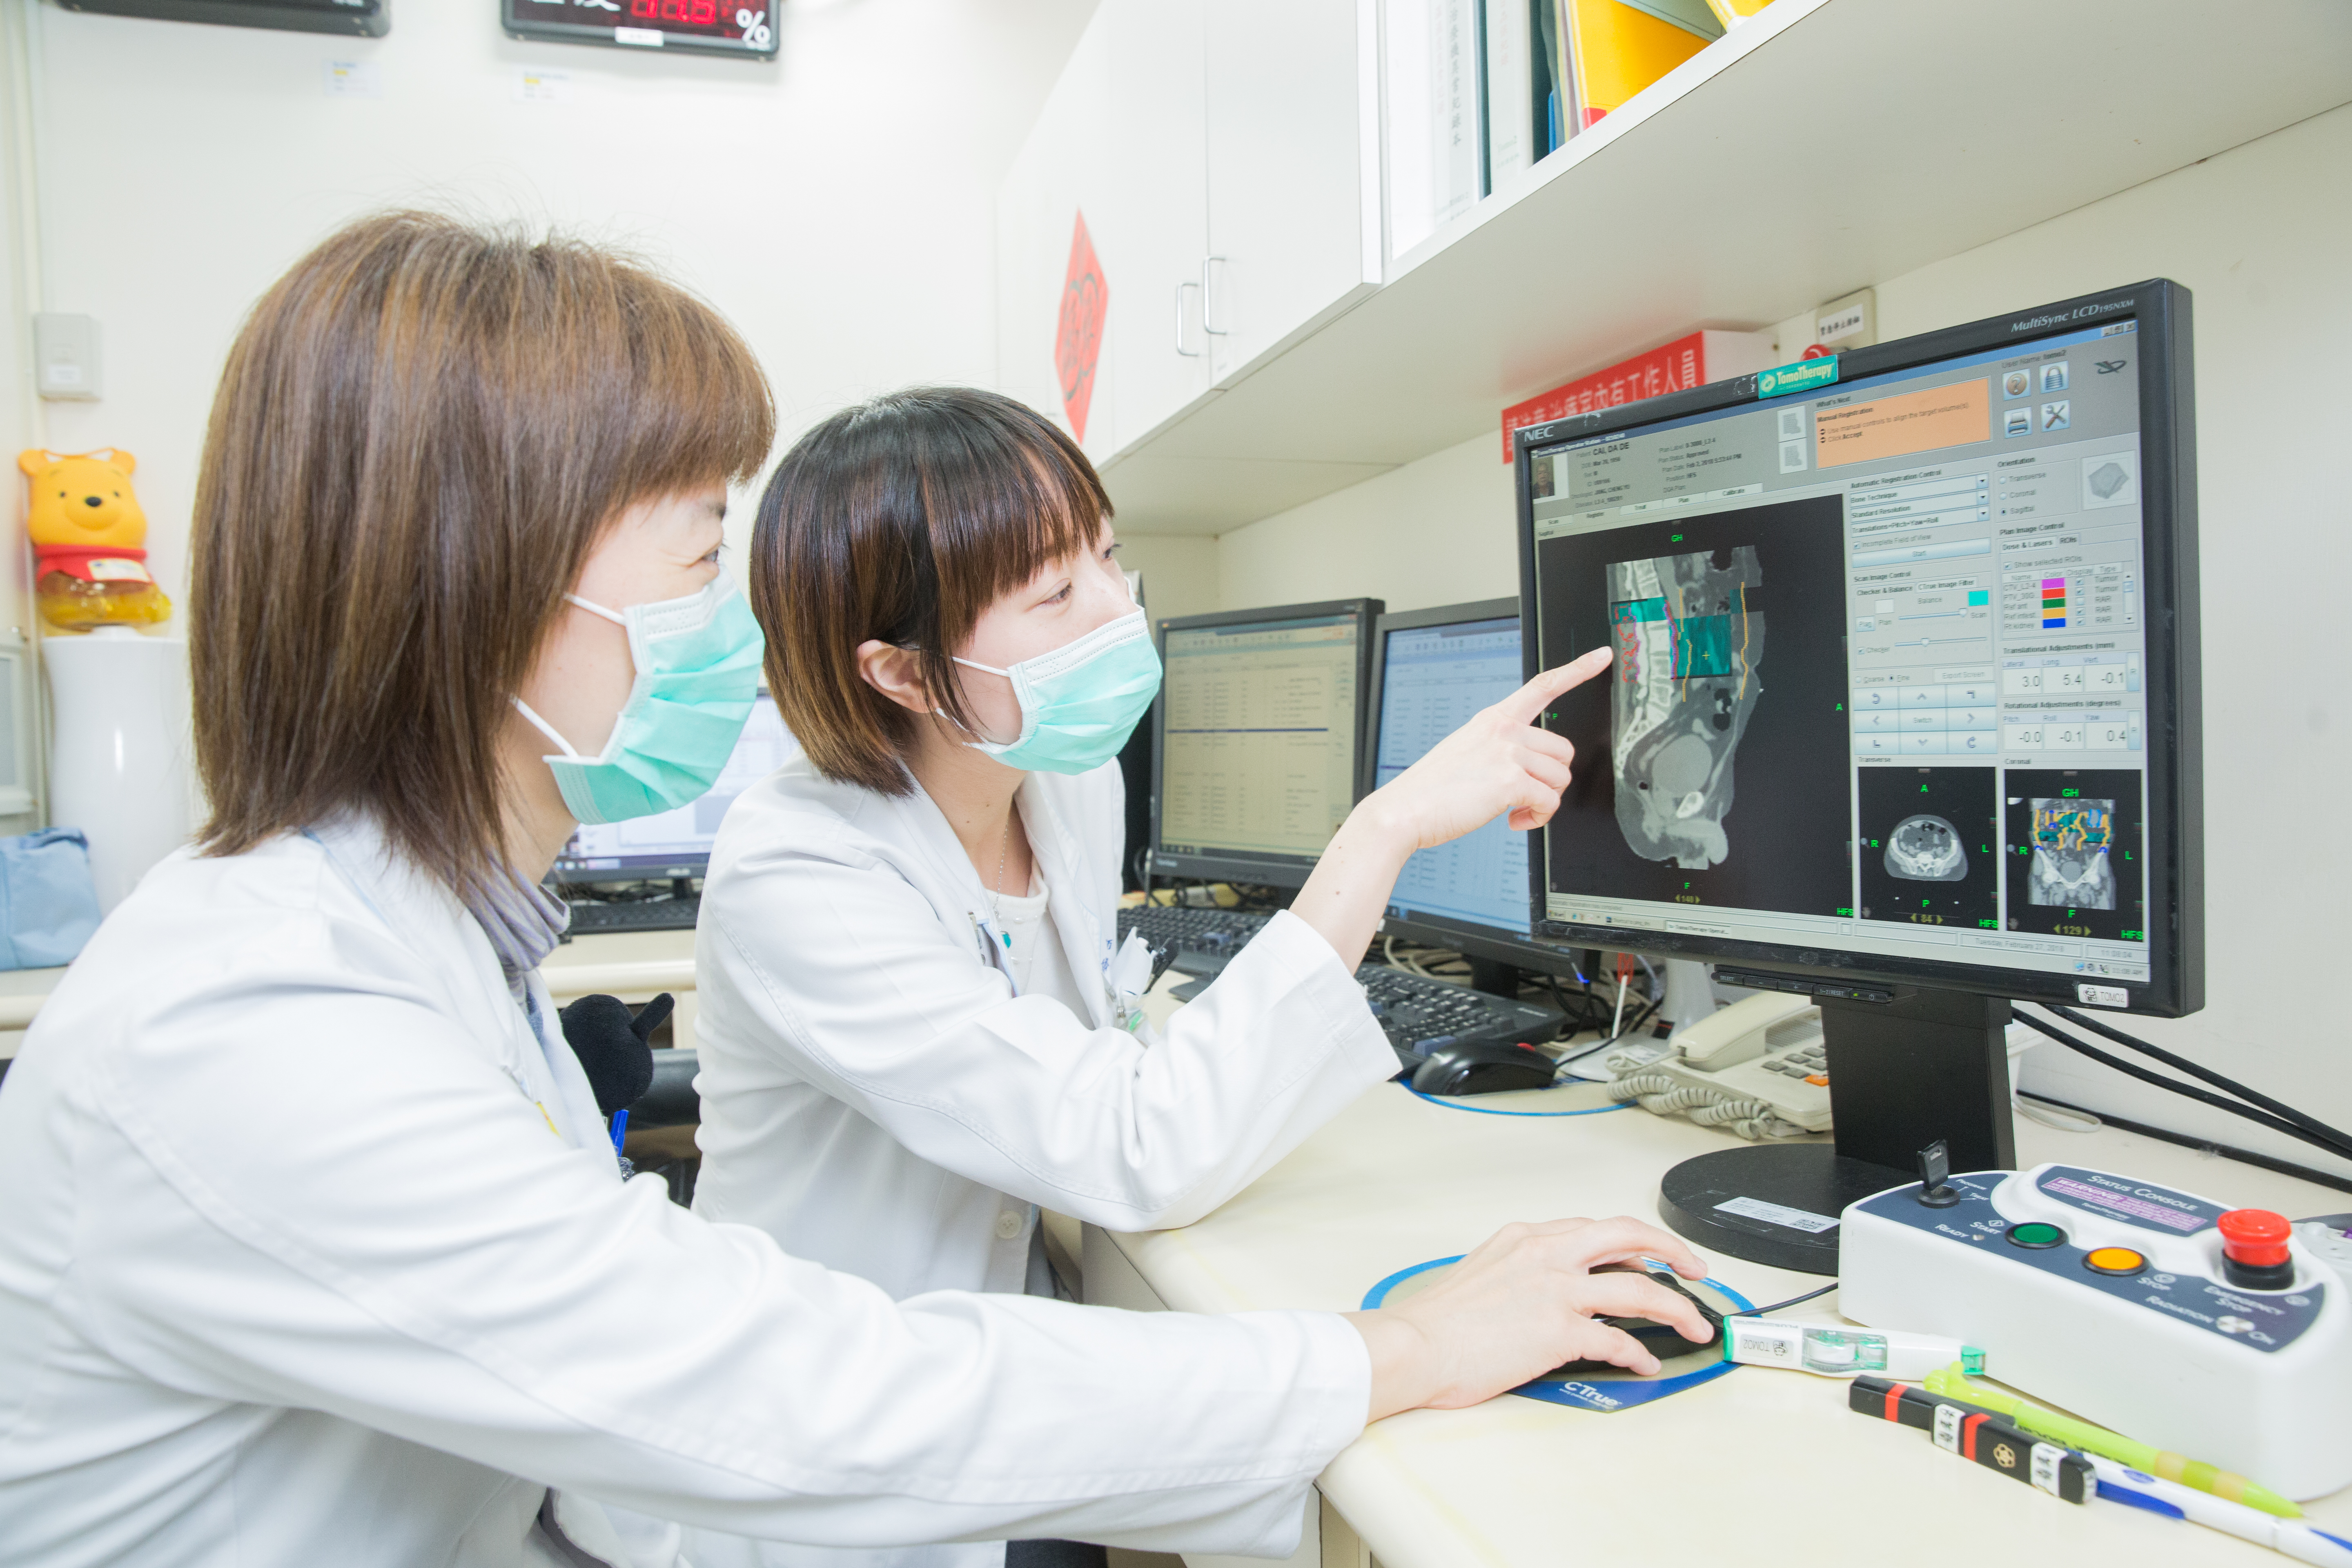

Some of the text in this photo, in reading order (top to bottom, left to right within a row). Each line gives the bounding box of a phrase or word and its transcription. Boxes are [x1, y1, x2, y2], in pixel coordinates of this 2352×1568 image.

[736, 8, 771, 44] %
[2011, 313, 2069, 332] MultiSync
[1776, 363, 1835, 385] TomoTherapy
[1778, 381, 1811, 390] INCORPORATED
[1816, 399, 1836, 408] What's
[1817, 408, 1873, 423] Manual Registration
[1840, 423, 1861, 431] manual
[1862, 419, 1885, 427] controls
[1919, 408, 1937, 417] target
[1524, 425, 1555, 442] NEC
[1619, 442, 1629, 450] DE
[1686, 450, 1710, 459] Approved
[1997, 457, 2036, 468] Orientation
[1851, 469, 1942, 488] Automatic Registration Control
[2009, 472, 2047, 482] Transverse
[1722, 488, 1745, 497] Calibrate
[1867, 492, 1898, 501] Technique
[2009, 489, 2036, 499] Coronal
[1586, 510, 1604, 519] Register
[1851, 506, 1911, 519] Standard Resolution
[2009, 505, 2035, 515] Sagittal
[2038, 522, 2065, 531] Control
[1671, 534, 1683, 542] GH
[1862, 539, 1893, 548] Incomplete
[2028, 539, 2053, 548] Lasers
[2034, 557, 2063, 566] selected
[2064, 555, 2082, 563] ROIs
[2066, 568, 2093, 576] Display
[1856, 588, 1881, 596] Checker
[1917, 596, 1943, 604] Balance
[2013, 621, 2035, 630] kidney
[2003, 641, 2115, 654] Translational Adjustments (mm)
[1942, 672, 1962, 680] Export
[2022, 675, 2040, 687] 3.0
[2063, 674, 2082, 686] 5.4
[2100, 672, 2124, 684] -0.1
[1835, 703, 1843, 711] A
[2085, 699, 2121, 708] (degrees)
[2018, 731, 2042, 743] -0.0
[2059, 731, 2081, 742] -0.1
[2107, 730, 2126, 742] 0.4
[1920, 784, 1929, 793] A
[2062, 788, 2079, 797] GH
[2019, 846, 2028, 855] R
[2125, 851, 2133, 860] L
[1837, 908, 1854, 916] HFS
[2068, 910, 2075, 918] F
[1979, 919, 1998, 929] HFS
[2062, 926, 2082, 935] 129
[2121, 931, 2143, 940] HFS
[2004, 940, 2034, 951] February
[2099, 991, 2125, 1003] TOMO2
[1956, 1179, 1987, 1190] PROGRAM
[2056, 1179, 2123, 1201] WARNING:
[1969, 1192, 1990, 1200] TREAT
[1935, 1224, 1969, 1238] READY
[1970, 1222, 2002, 1234] START
[2136, 1277, 2172, 1291] STOP
[2203, 1285, 2285, 1316] EMERGENCY
[2215, 1296, 2253, 1313] STOP
[2145, 1295, 2215, 1323] RADIATION
[1743, 1339, 1771, 1352] TOMO2
